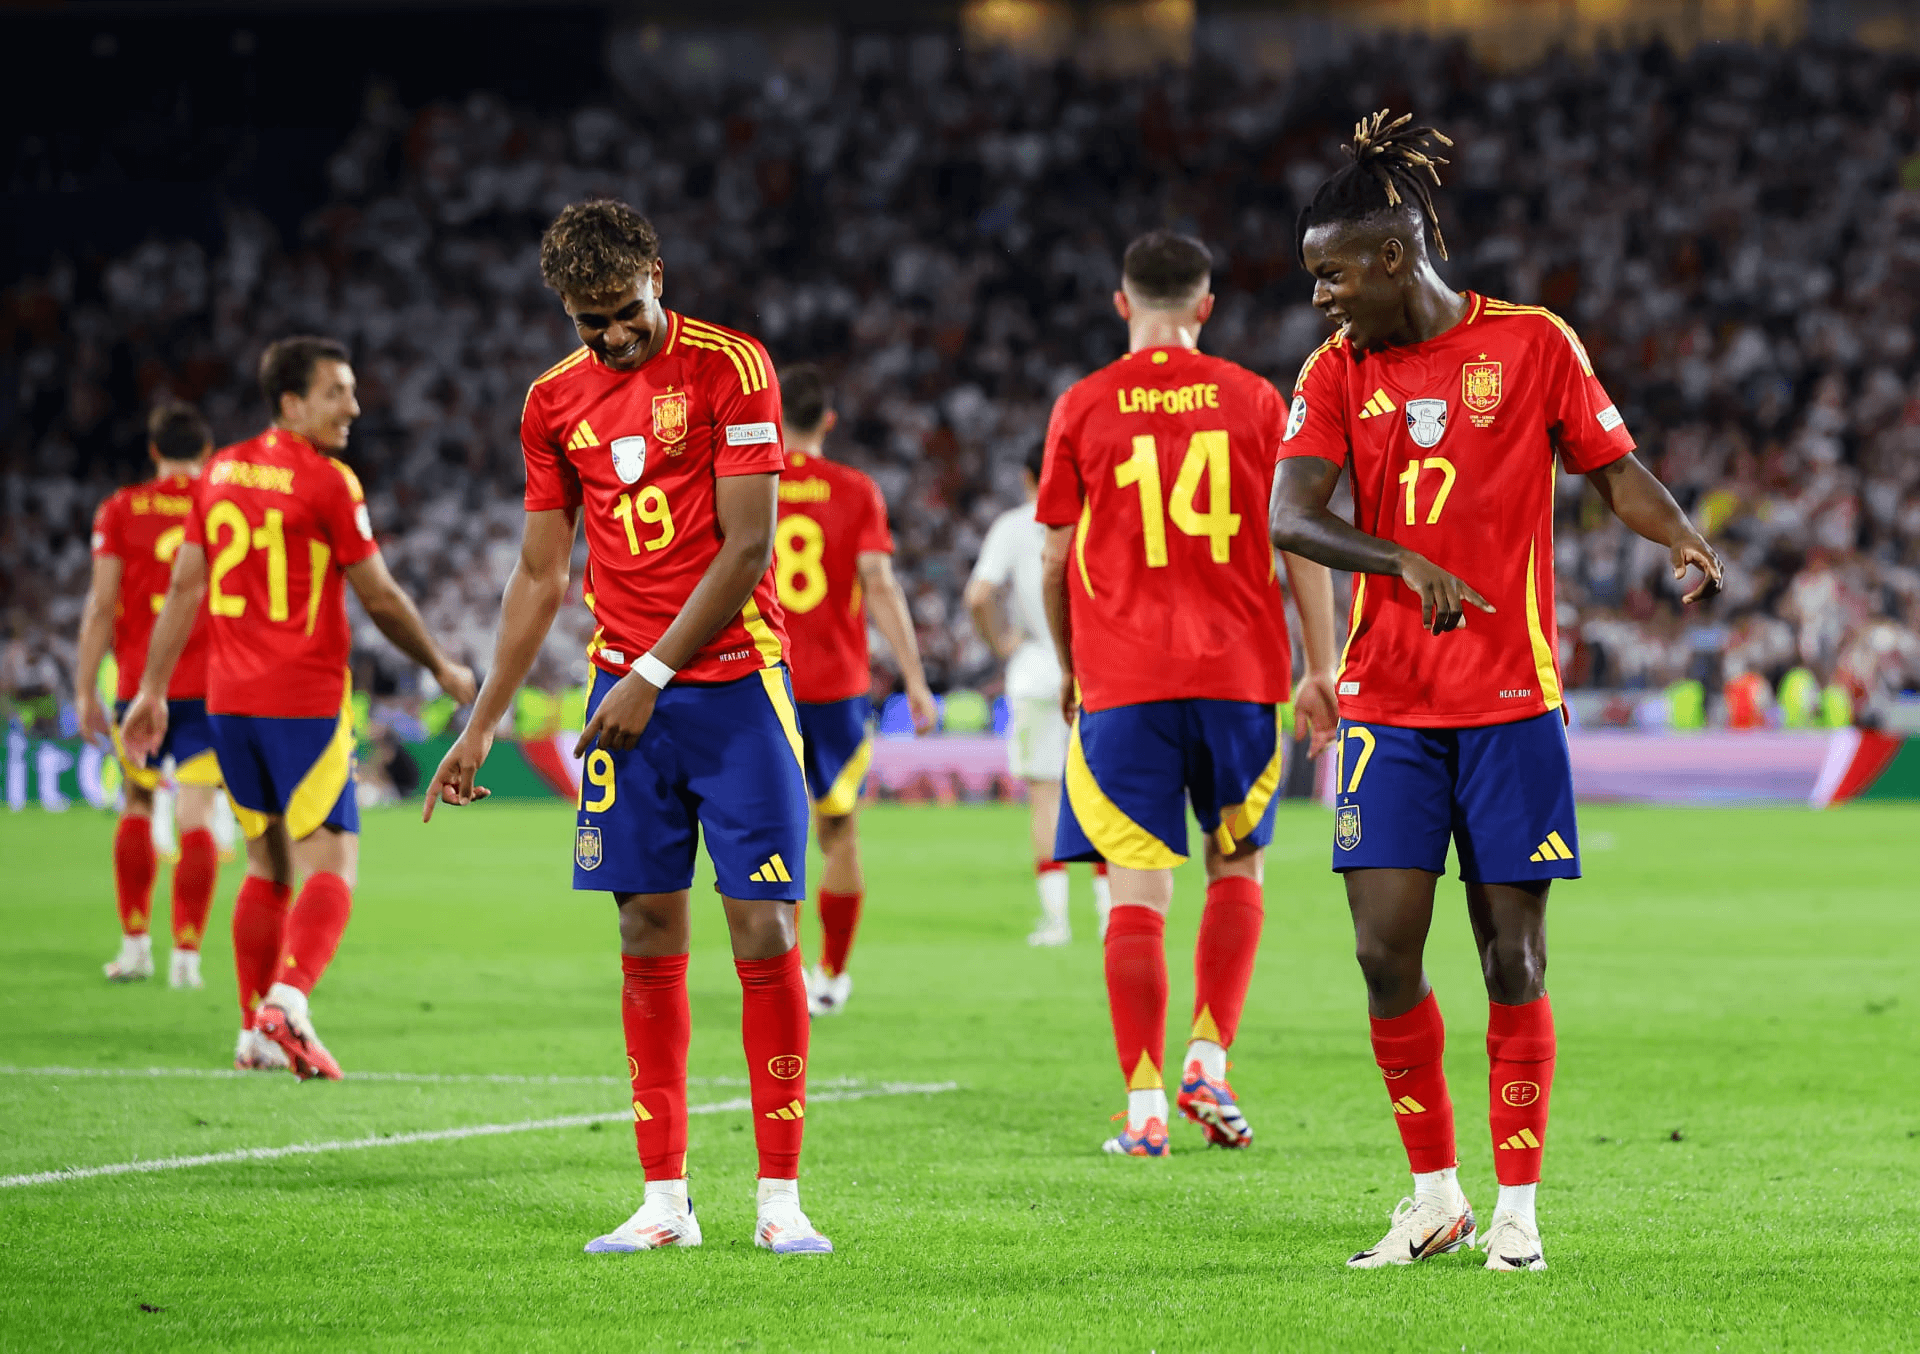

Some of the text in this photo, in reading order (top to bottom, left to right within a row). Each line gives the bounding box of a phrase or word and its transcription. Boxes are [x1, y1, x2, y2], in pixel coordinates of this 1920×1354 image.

[1117, 384, 1220, 414] LAPORTE
[613, 485, 675, 556] 19
[1114, 430, 1242, 568] 14
[1399, 457, 1456, 525] 17
[206, 499, 289, 622] 21
[774, 513, 828, 614] 8
[1337, 726, 1376, 794] 17
